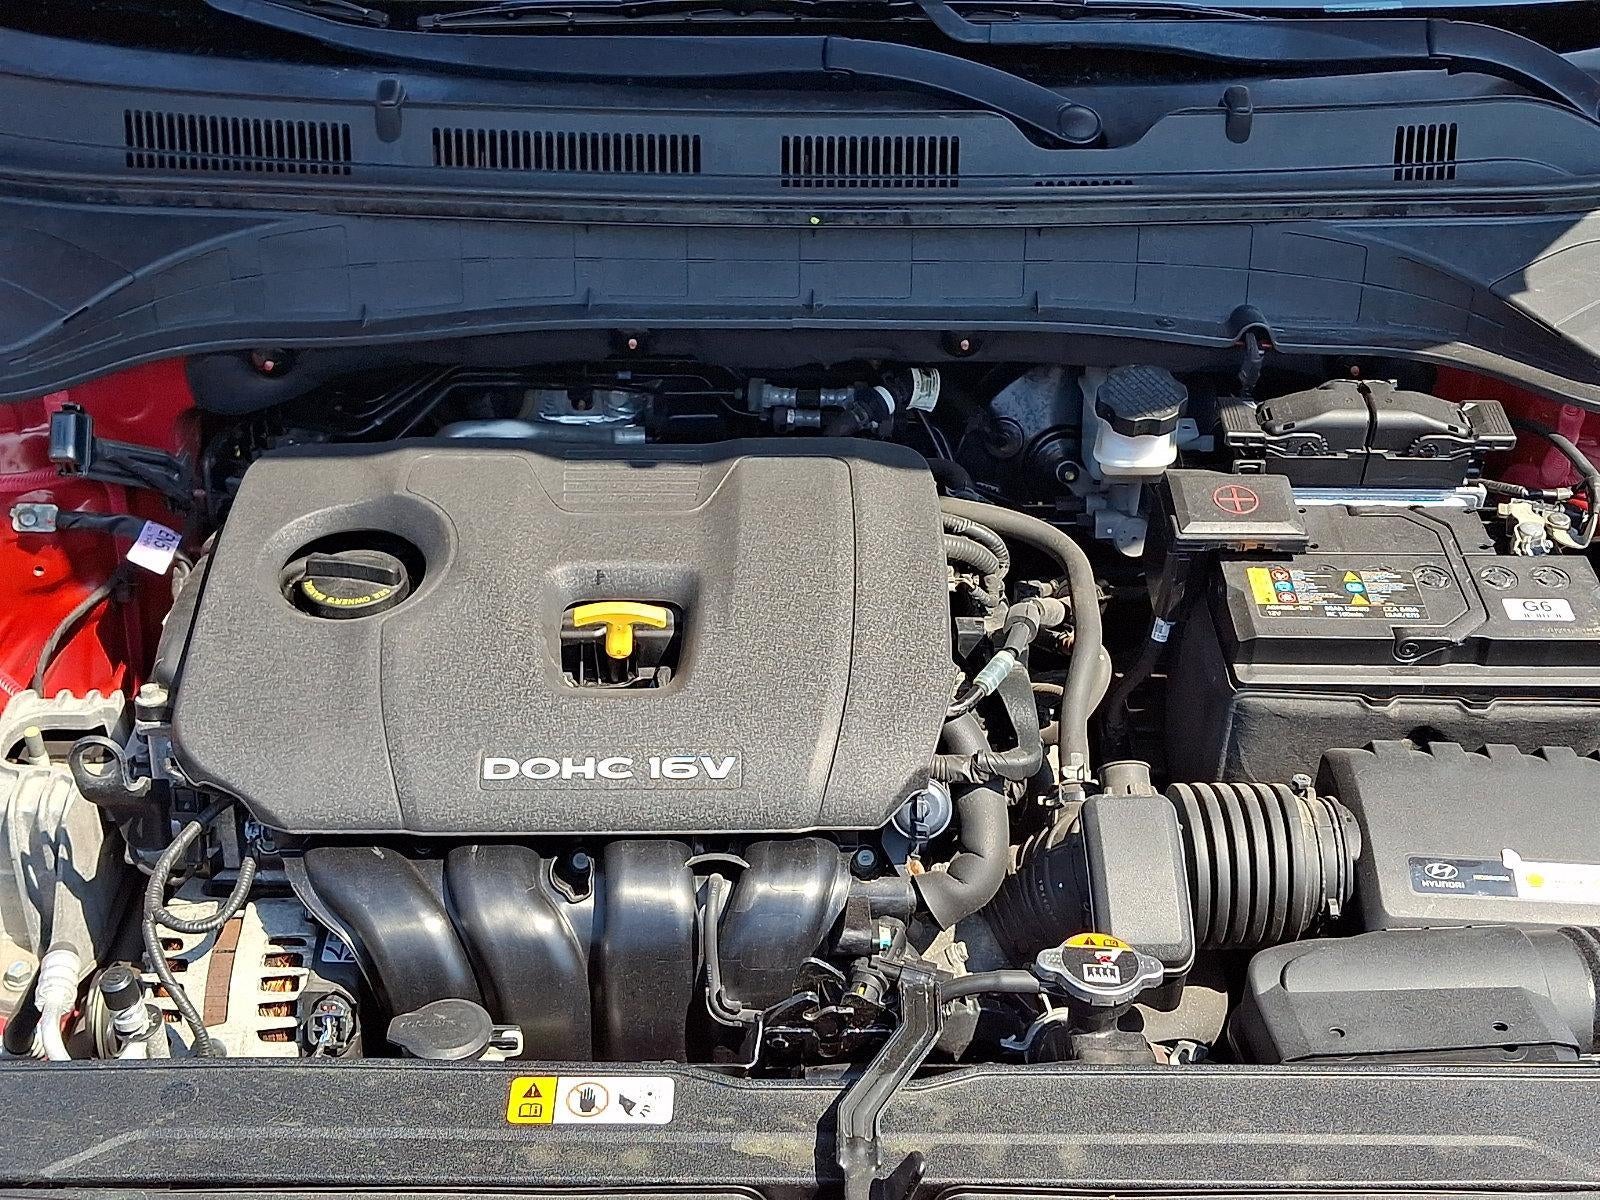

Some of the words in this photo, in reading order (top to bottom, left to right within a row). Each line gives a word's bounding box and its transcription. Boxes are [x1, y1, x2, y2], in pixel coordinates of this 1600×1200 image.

[1522, 600, 1552, 612] G6
[483, 756, 634, 780] DOHC
[649, 756, 736, 780] 16V
[1421, 879, 1465, 889] HYUNDAI
